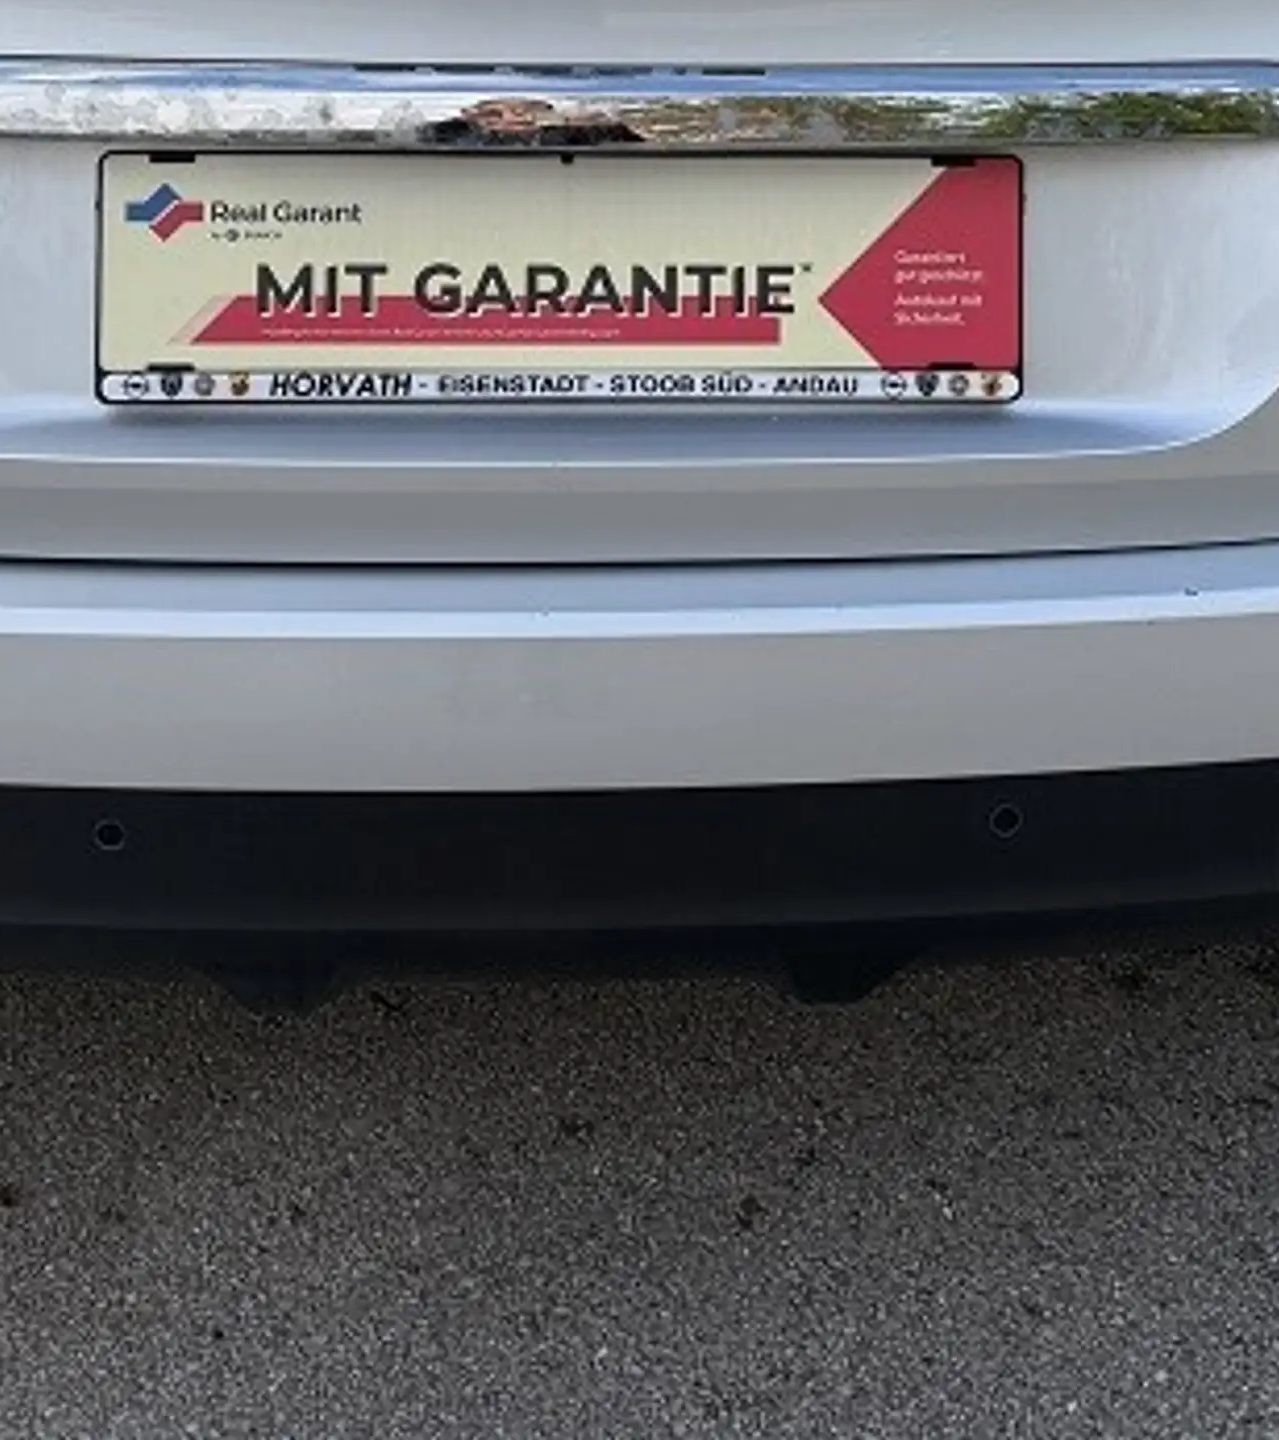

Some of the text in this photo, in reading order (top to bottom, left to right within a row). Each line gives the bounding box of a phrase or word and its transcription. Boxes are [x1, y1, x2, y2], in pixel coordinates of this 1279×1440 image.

[210, 200, 362, 223] Real Garant
[256, 263, 389, 316] MIT
[271, 372, 413, 397] HORVATH
[438, 373, 590, 393] EISENSTADT
[610, 373, 696, 393] STOOB
[701, 370, 754, 394] SÜD
[773, 373, 859, 394] ANDAU
